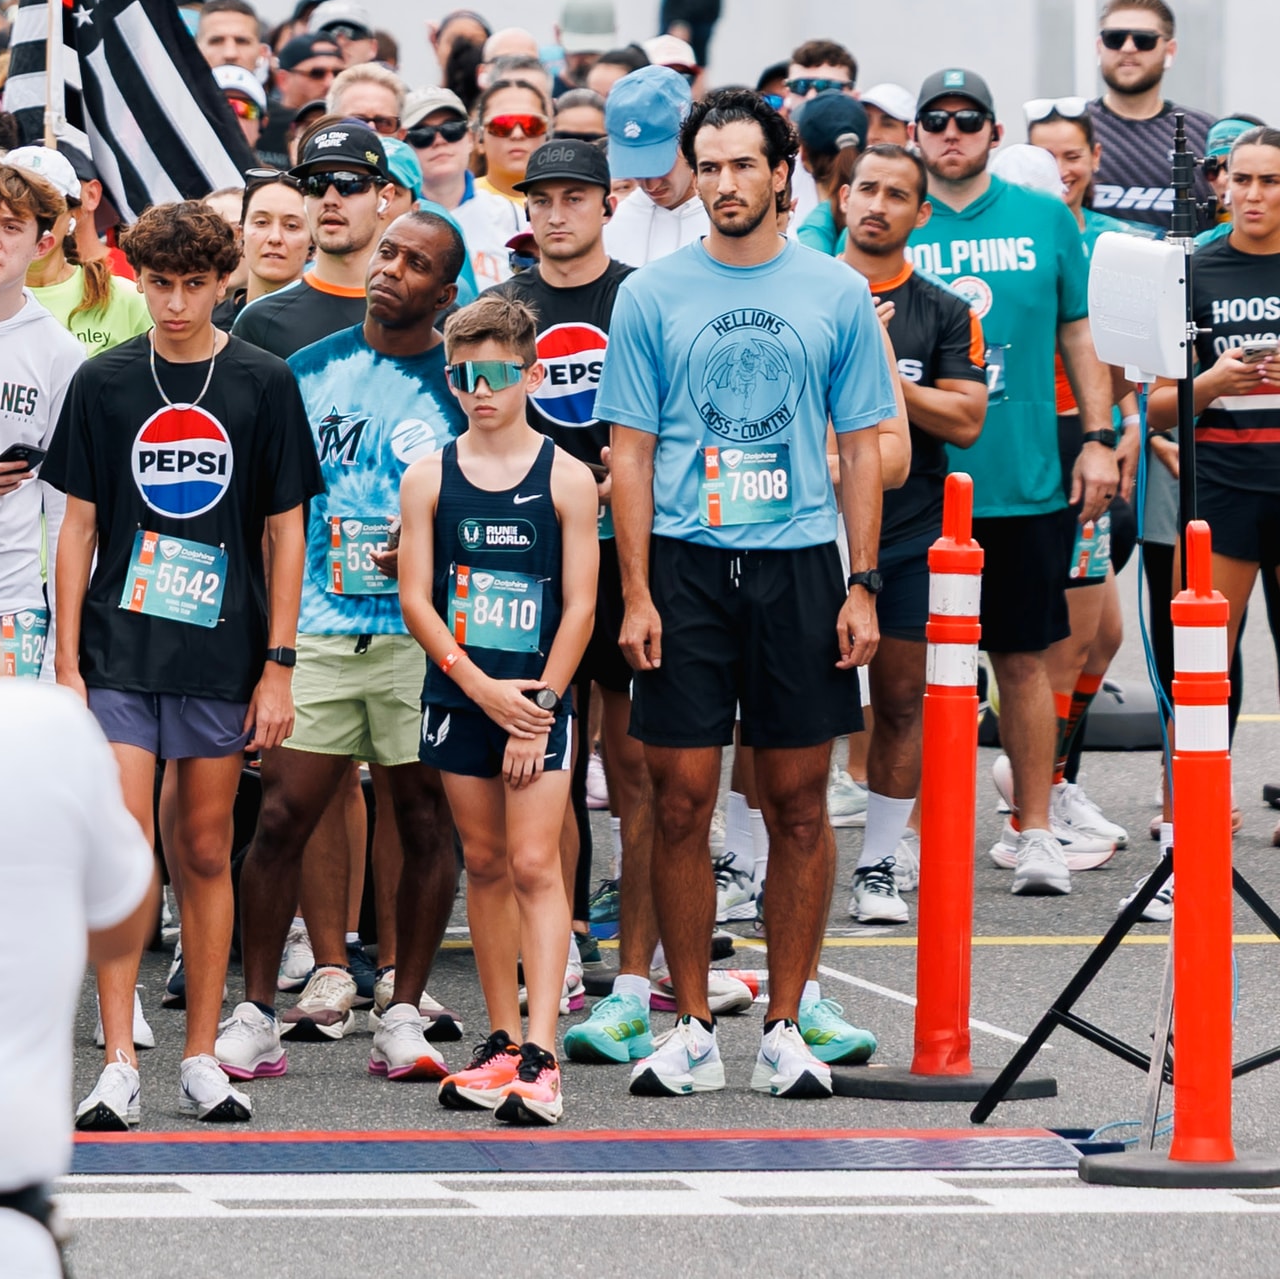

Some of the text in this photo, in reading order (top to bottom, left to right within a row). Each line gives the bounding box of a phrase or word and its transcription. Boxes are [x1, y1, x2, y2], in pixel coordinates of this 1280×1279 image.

[712, 311, 785, 337] HELLIONS
[76, 329, 111, 346] nley
[700, 401, 732, 435] CROSS
[740, 404, 792, 440] COUNTRY
[139, 449, 228, 476] PEPSI
[706, 455, 718, 467] 5K
[726, 469, 788, 502] 7808
[486, 526, 510, 535] RUN
[143, 539, 156, 553] 5K
[486, 535, 531, 546] WORLD.
[156, 563, 220, 605] 5542
[457, 574, 468, 586] 5K
[135, 590, 142, 601] A
[473, 595, 537, 630] 8410
